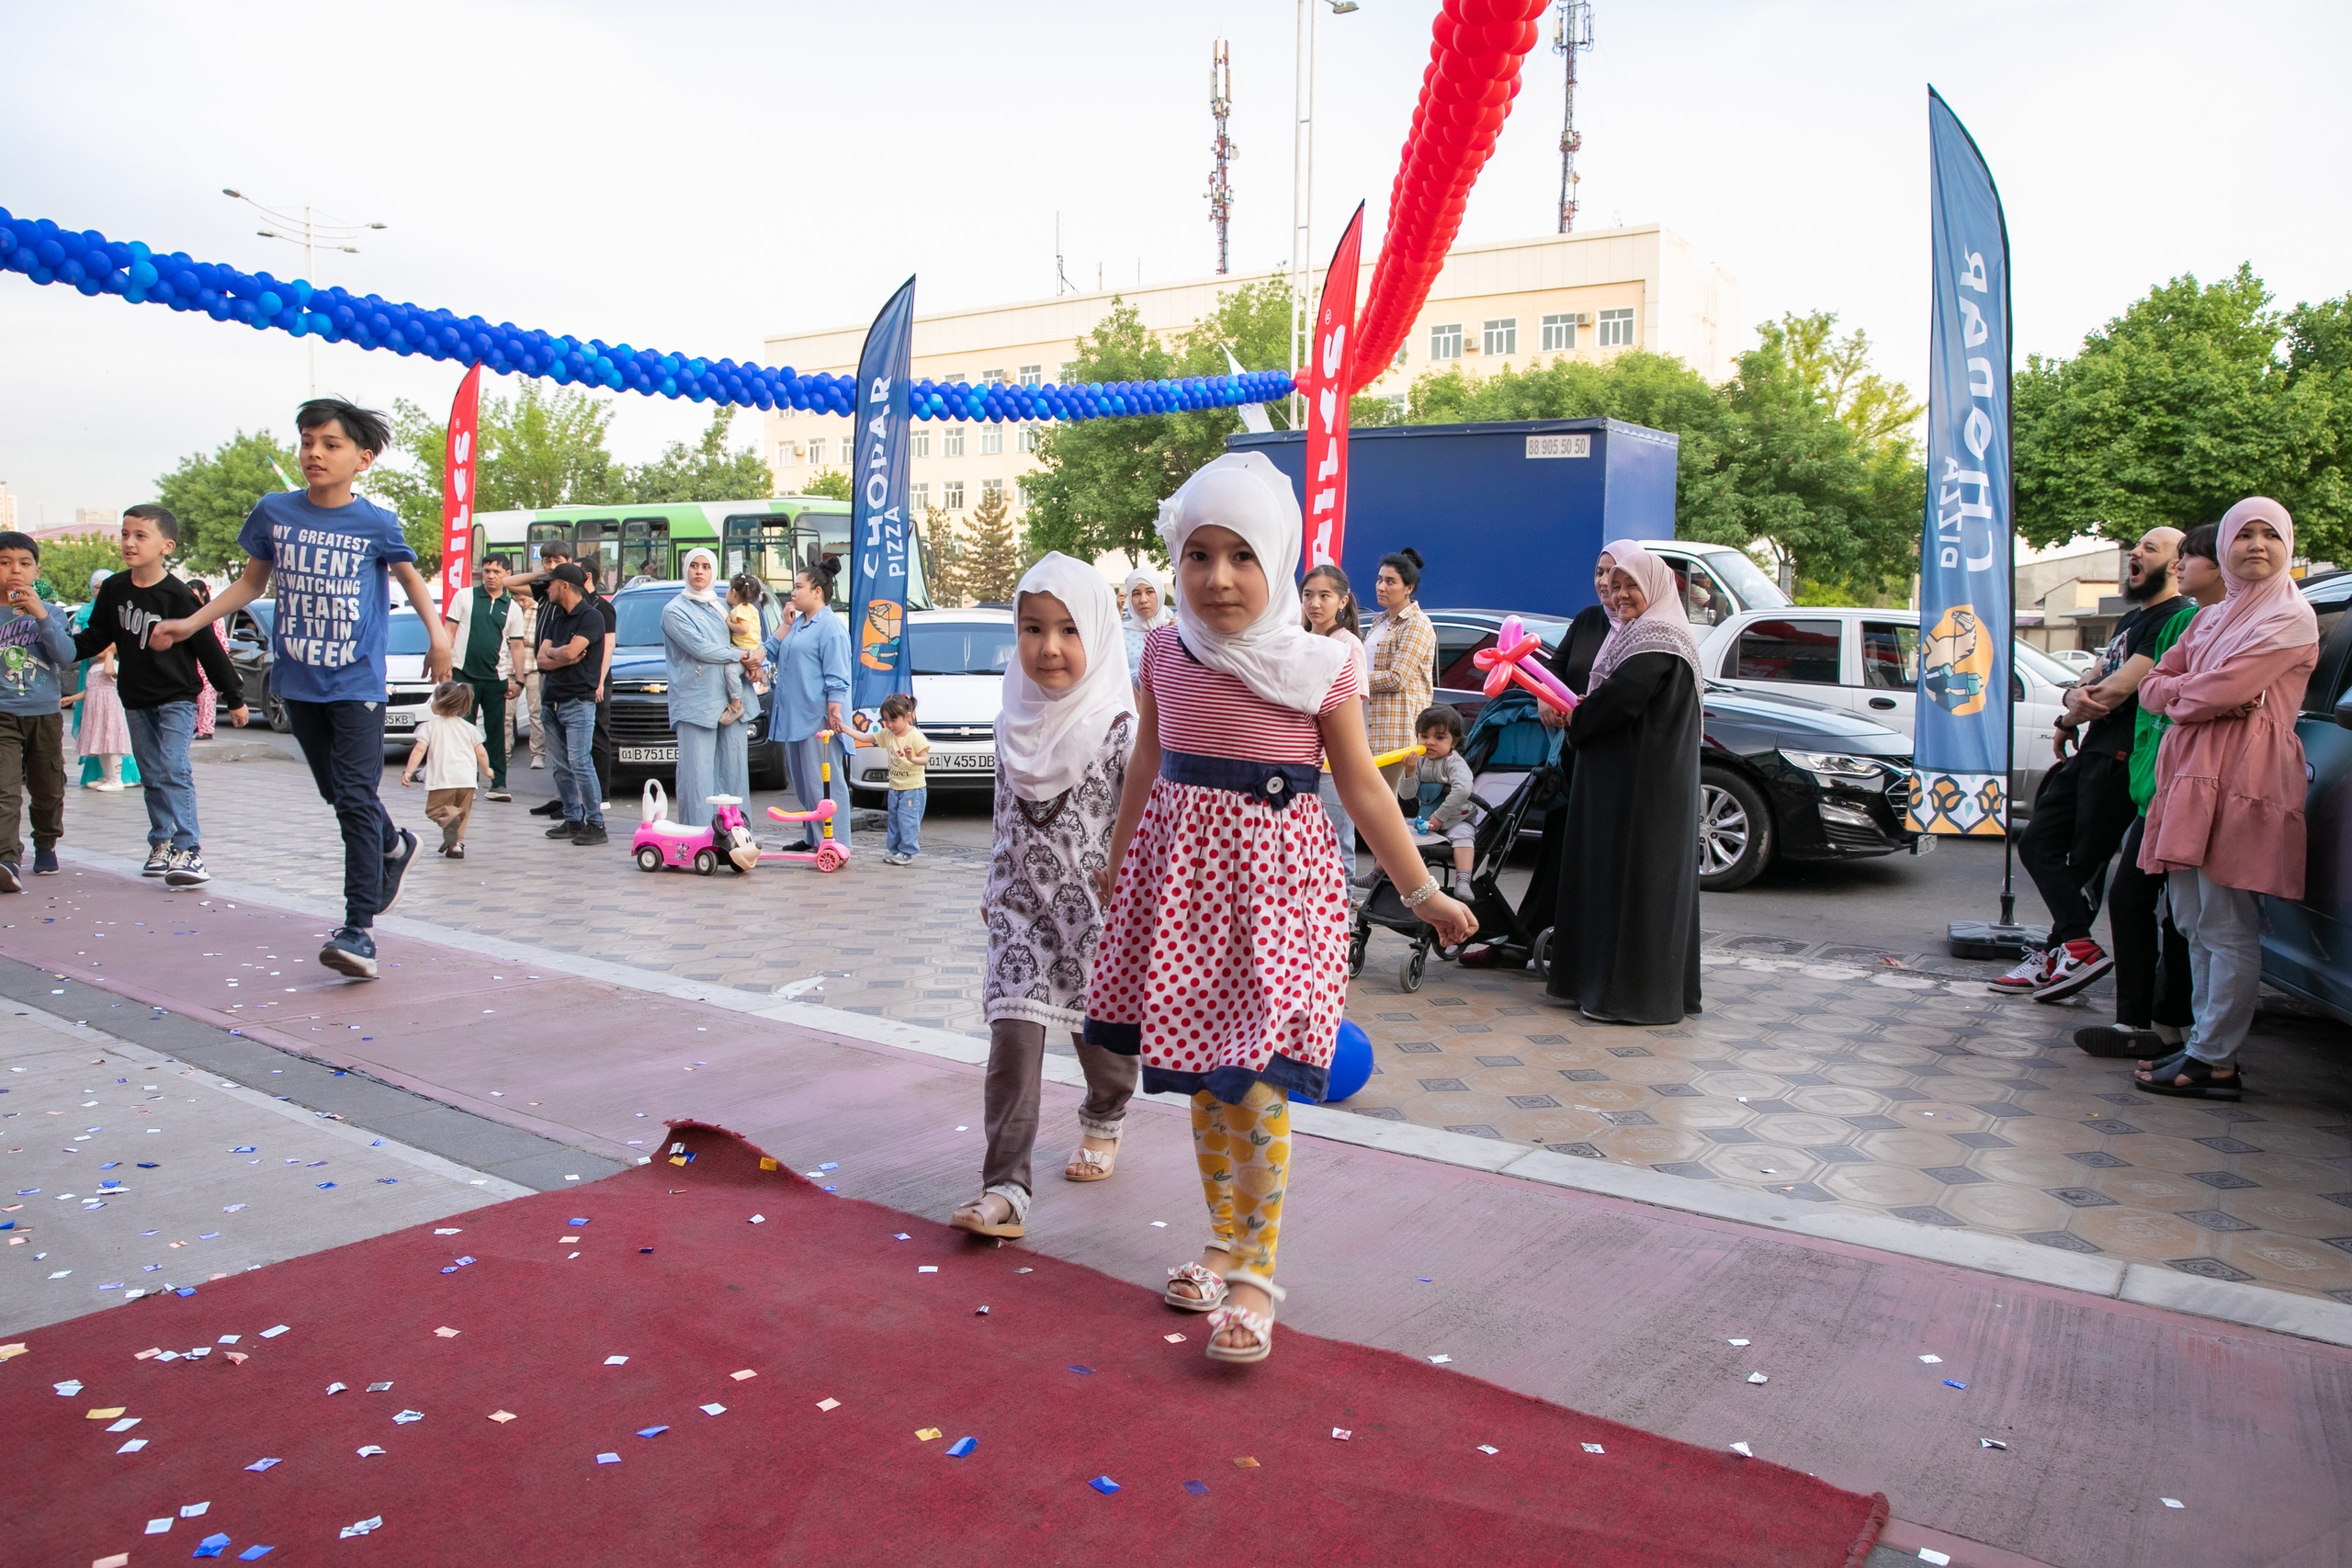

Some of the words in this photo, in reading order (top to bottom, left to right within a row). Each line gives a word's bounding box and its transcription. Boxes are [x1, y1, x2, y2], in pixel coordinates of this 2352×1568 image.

[1528, 439, 1540, 455] 88
[1542, 439, 1558, 455] 905
[1561, 438, 1572, 455] 50
[1575, 438, 1586, 454] 50
[863, 375, 891, 579] CHOPAR
[273, 525, 292, 540] MY
[298, 529, 371, 553] GREATEST
[884, 505, 906, 577] PIZZA
[274, 542, 365, 578] TALENT
[277, 570, 286, 587] IS
[287, 573, 361, 595] WATCHING
[288, 592, 360, 621] YEARS
[303, 617, 326, 637] TV
[333, 620, 352, 640] IN
[284, 637, 358, 668] WEEK
[621, 750, 633, 760] 01
[929, 756, 941, 767] 01
[953, 755, 977, 768] 455
[978, 755, 995, 768] DB
